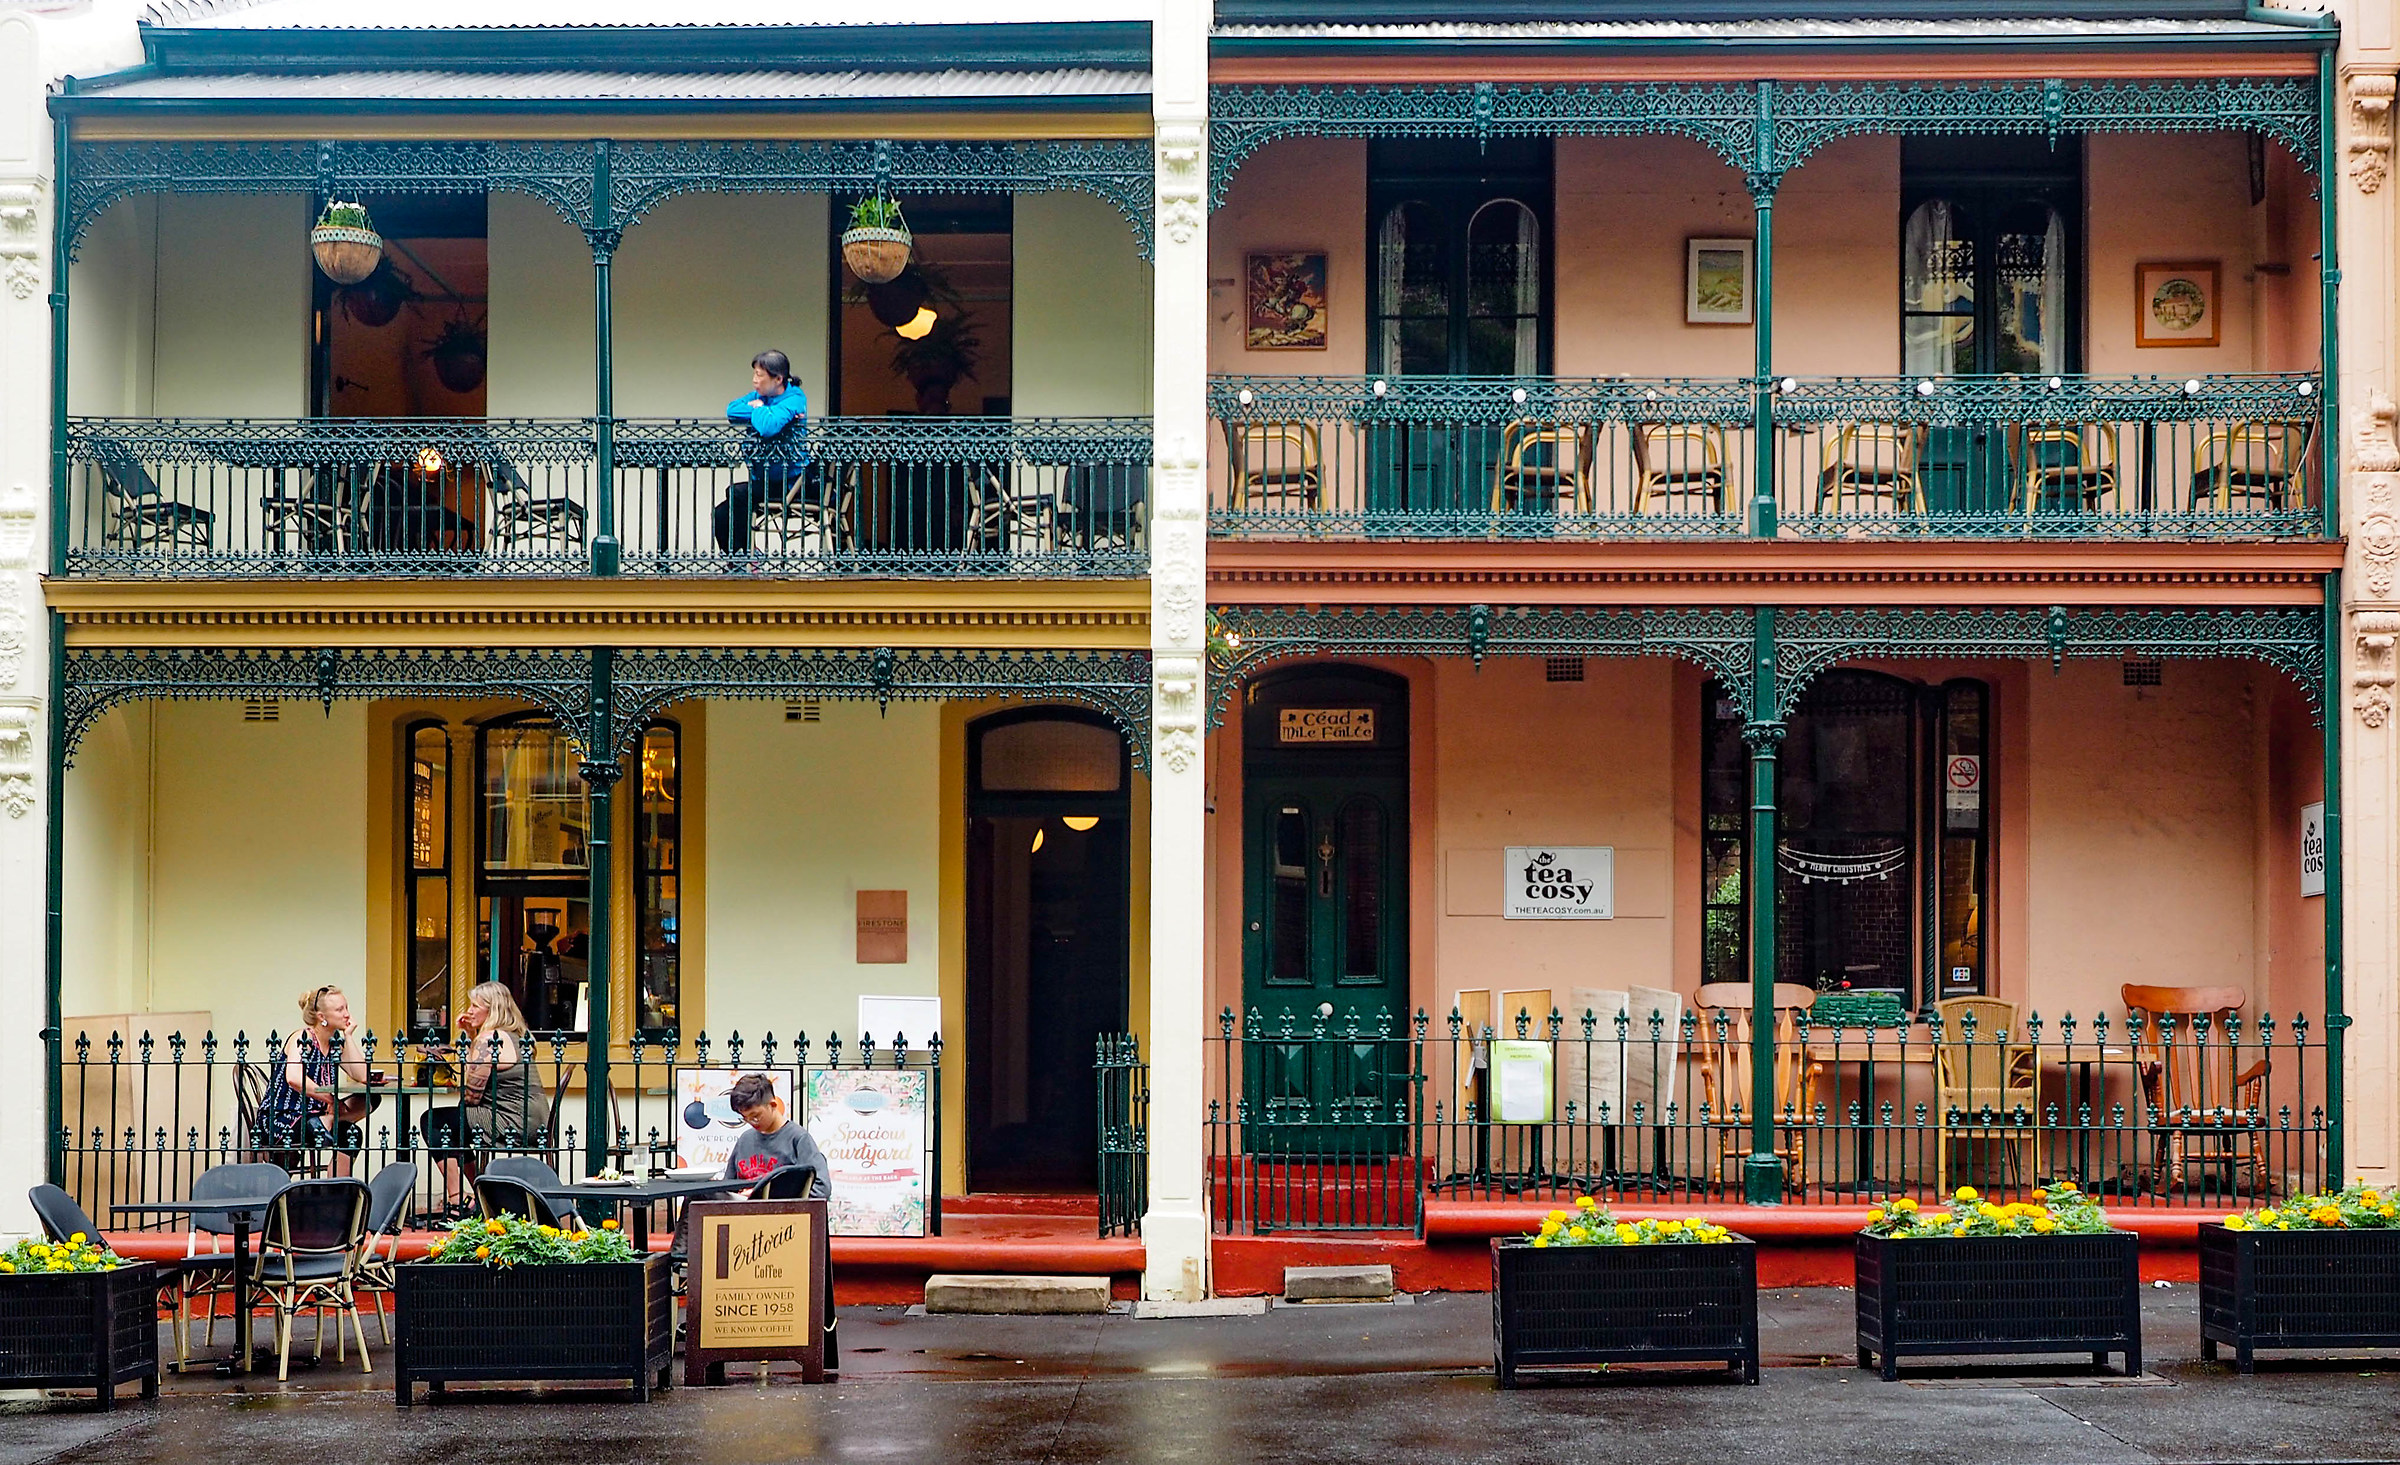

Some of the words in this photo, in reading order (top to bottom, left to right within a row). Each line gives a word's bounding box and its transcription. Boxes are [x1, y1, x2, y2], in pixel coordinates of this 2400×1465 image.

[1303, 711, 1350, 726] Céad
[2304, 835, 2322, 857] tea
[1539, 856, 1551, 864] the
[2304, 856, 2323, 874] cos
[1524, 862, 1572, 883] tea
[1810, 863, 1831, 873] MERRY
[1832, 864, 1871, 873] CHRISTMAS
[1526, 879, 1594, 905] cosy
[1515, 907, 1604, 915] THETEACOSY.com.au
[833, 1122, 906, 1144] Spacious
[818, 1140, 913, 1168] Courtyard
[733, 1224, 795, 1271] Vittoria
[754, 1264, 783, 1278] Coffee
[715, 1293, 754, 1301] FAMILY
[756, 1291, 795, 1300] OWNED
[715, 1304, 758, 1317] SINCE
[763, 1303, 794, 1315] 1958
[714, 1326, 729, 1334] WE
[759, 1325, 793, 1333] COFFEE
